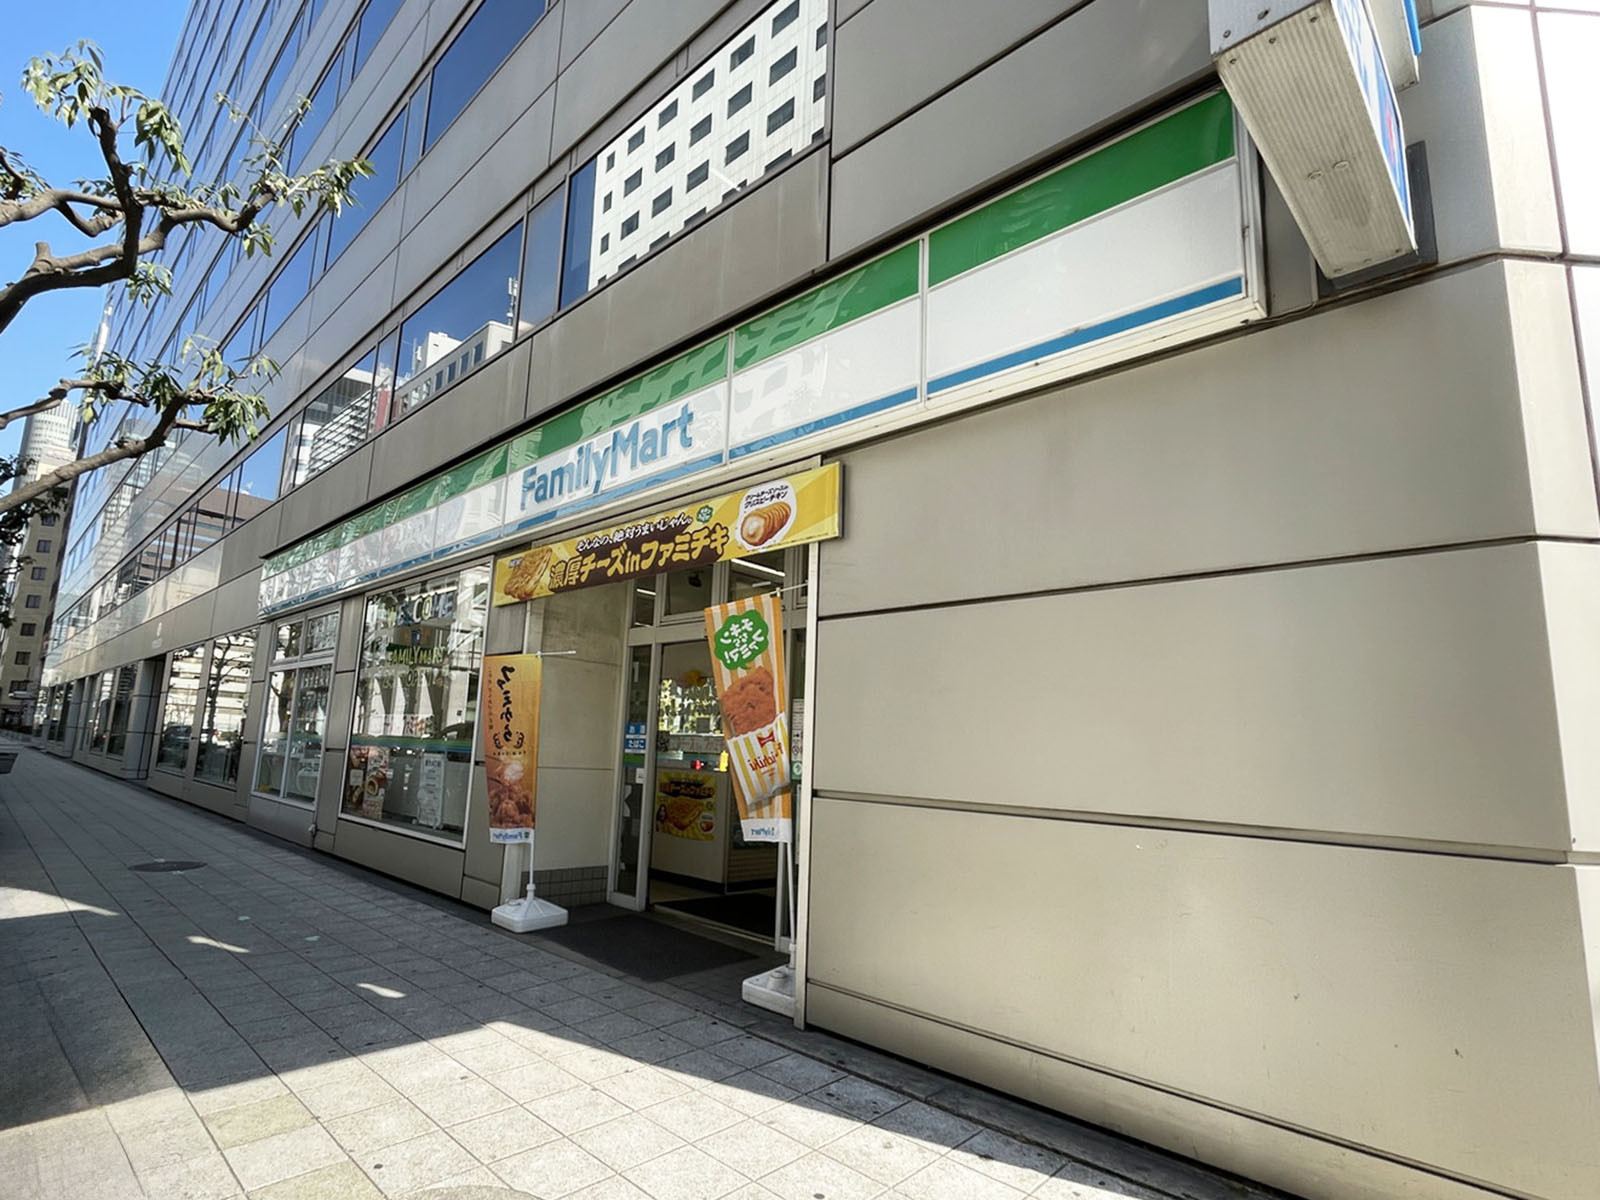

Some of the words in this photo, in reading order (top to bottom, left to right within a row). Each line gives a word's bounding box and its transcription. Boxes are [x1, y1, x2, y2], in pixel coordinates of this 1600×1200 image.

[520, 403, 694, 511] FamilyMart
[548, 522, 729, 590] 濃厚チーズinファミチキ
[576, 512, 692, 551] そんなの、絶対うまいじゃん。
